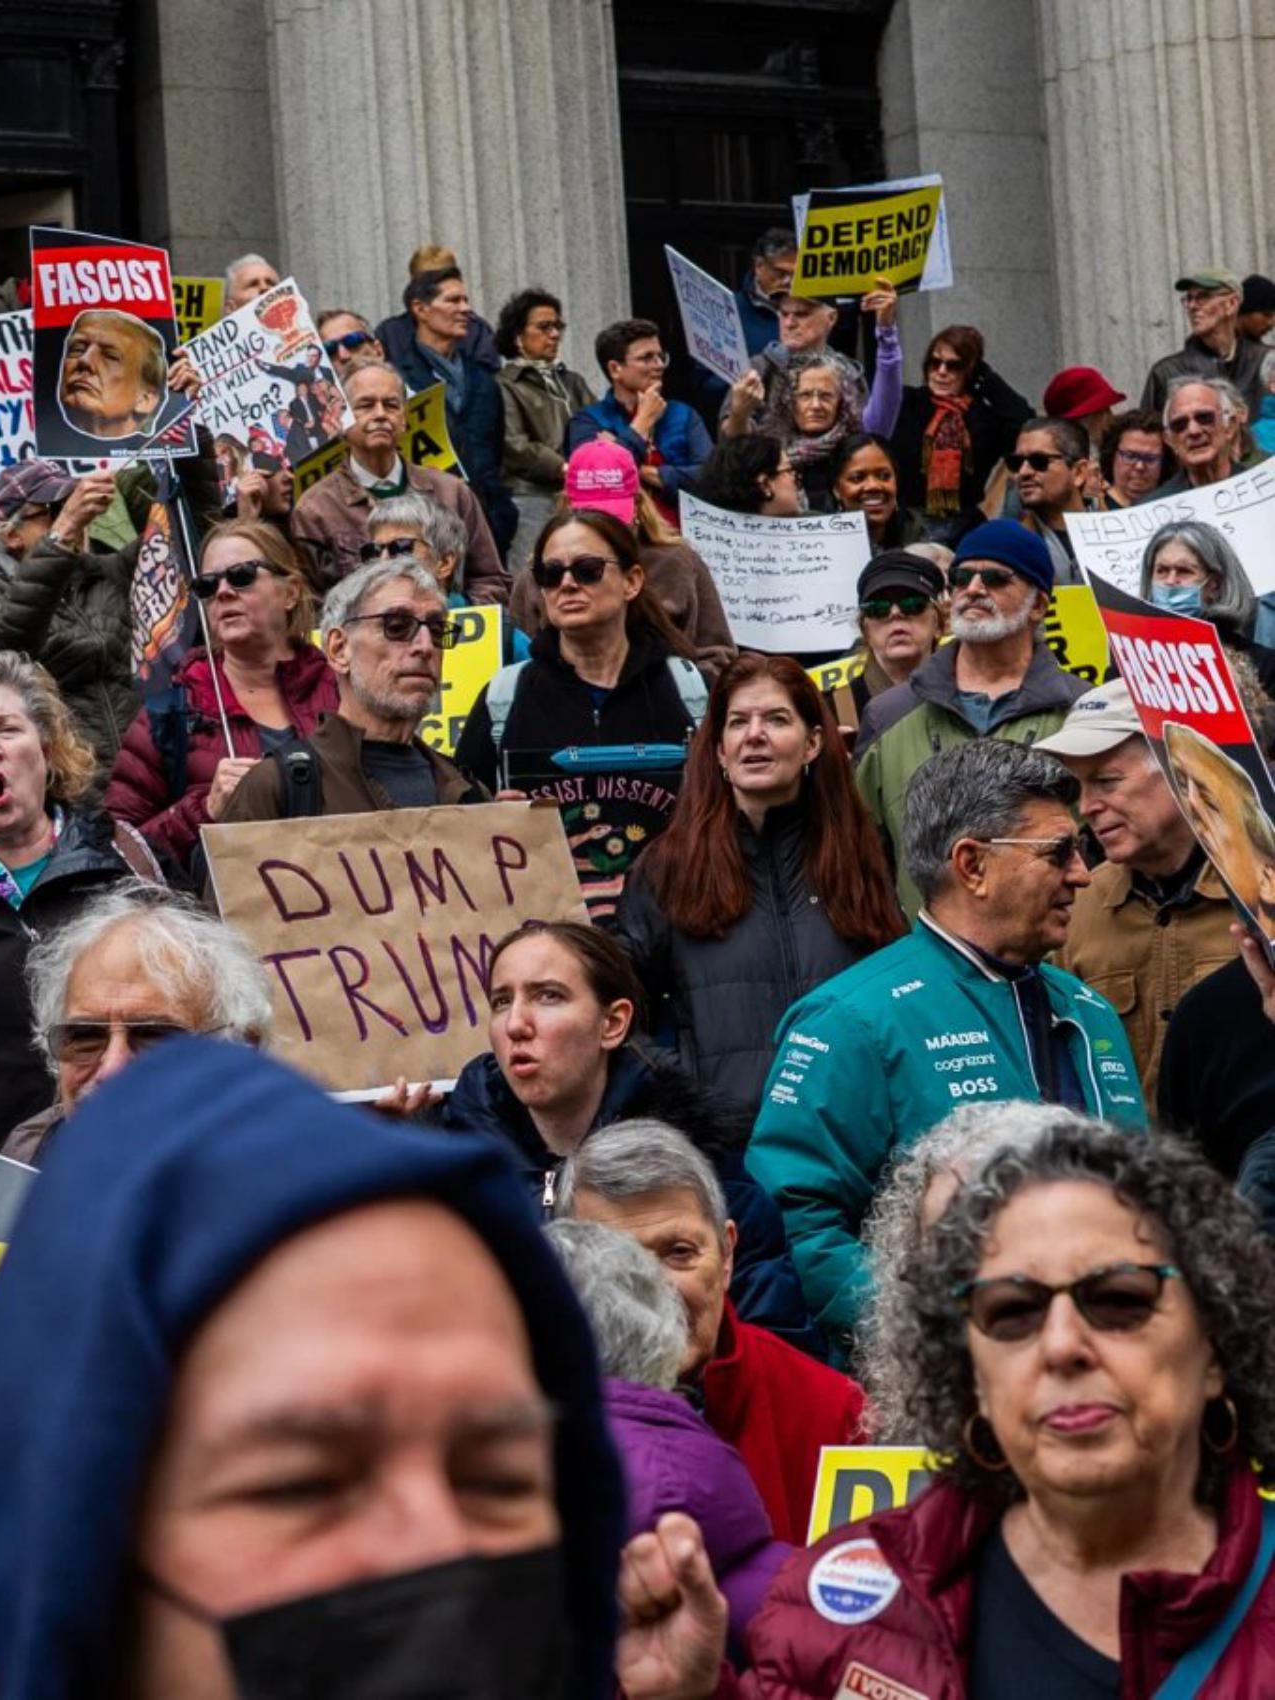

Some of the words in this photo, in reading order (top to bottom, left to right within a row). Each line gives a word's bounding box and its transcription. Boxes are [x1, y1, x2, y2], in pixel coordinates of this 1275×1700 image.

[806, 203, 931, 249] DEFEND
[38, 259, 167, 308] FASCIST
[188, 320, 238, 363] TAND
[200, 331, 266, 381] THING
[1076, 500, 1196, 541] HANDS
[1214, 470, 1275, 510] OFF
[1110, 632, 1236, 714] FASCIST
[530, 777, 591, 805] ESIST.
[258, 835, 528, 923] DUMP
[263, 920, 546, 1043] TRUM
[934, 1052, 996, 1073] cognizant
[948, 1076, 998, 1098] BOSS
